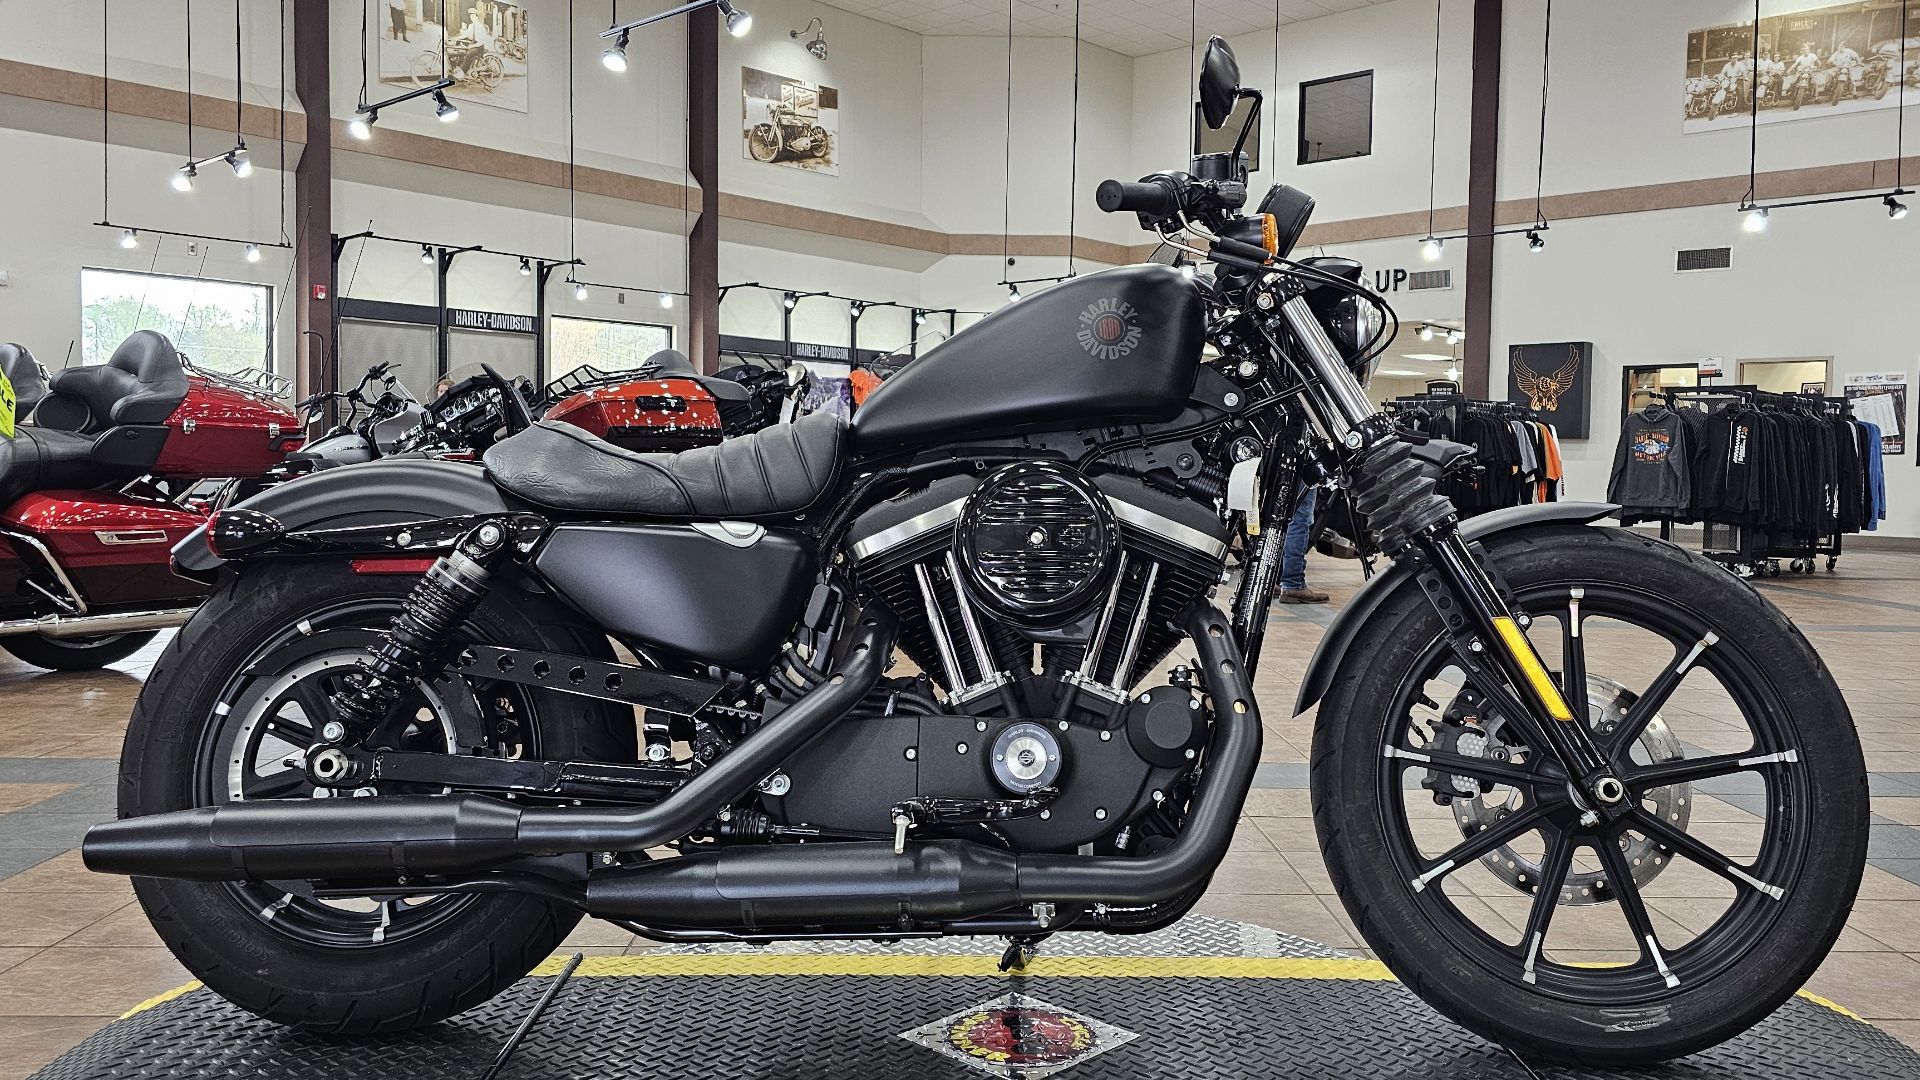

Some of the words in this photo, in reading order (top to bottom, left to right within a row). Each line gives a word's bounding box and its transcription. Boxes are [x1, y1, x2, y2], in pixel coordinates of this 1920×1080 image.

[1375, 268, 1407, 293] UP
[455, 310, 533, 332] HARLEY-DAVIDSON
[1078, 297, 1138, 324] HARLEY
[796, 343, 849, 360] HARLEY-DAVIDSON
[1077, 325, 1142, 360] DAVIDSON
[0, 387, 14, 413] LE
[1010, 780, 1024, 788] MOTOR
[1024, 781, 1042, 789] COMPANY
